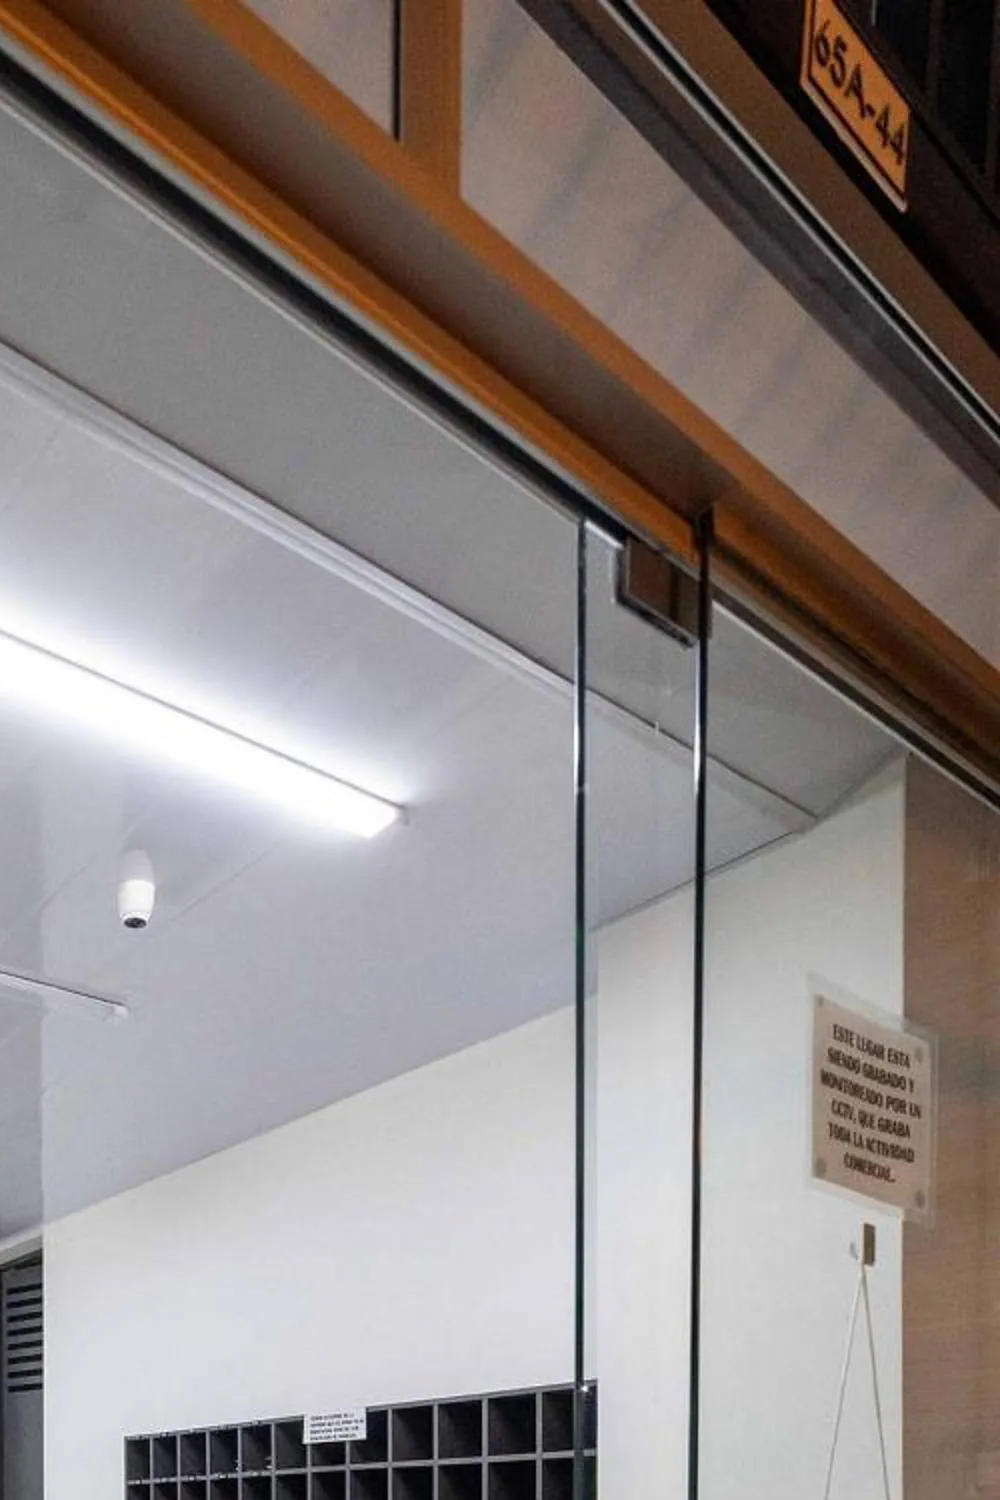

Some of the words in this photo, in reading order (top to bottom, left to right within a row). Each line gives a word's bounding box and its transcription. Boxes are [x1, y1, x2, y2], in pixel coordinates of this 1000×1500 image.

[814, 20, 905, 166] 65A-44
[832, 1023, 854, 1048] ESTE
[856, 1035, 885, 1060] LUGAR
[887, 1047, 911, 1068] ESTA
[827, 1046, 861, 1074] SIENDO
[862, 1062, 907, 1091] GRABADO
[908, 1076, 916, 1094] Y
[858, 1109, 876, 1129] QUE
[878, 1117, 911, 1139] GRABA
[886, 1096, 907, 1115] POR
[828, 1121, 851, 1143] TODA
[853, 1131, 865, 1149] LA
[865, 1137, 915, 1164] ACTIVIDAD
